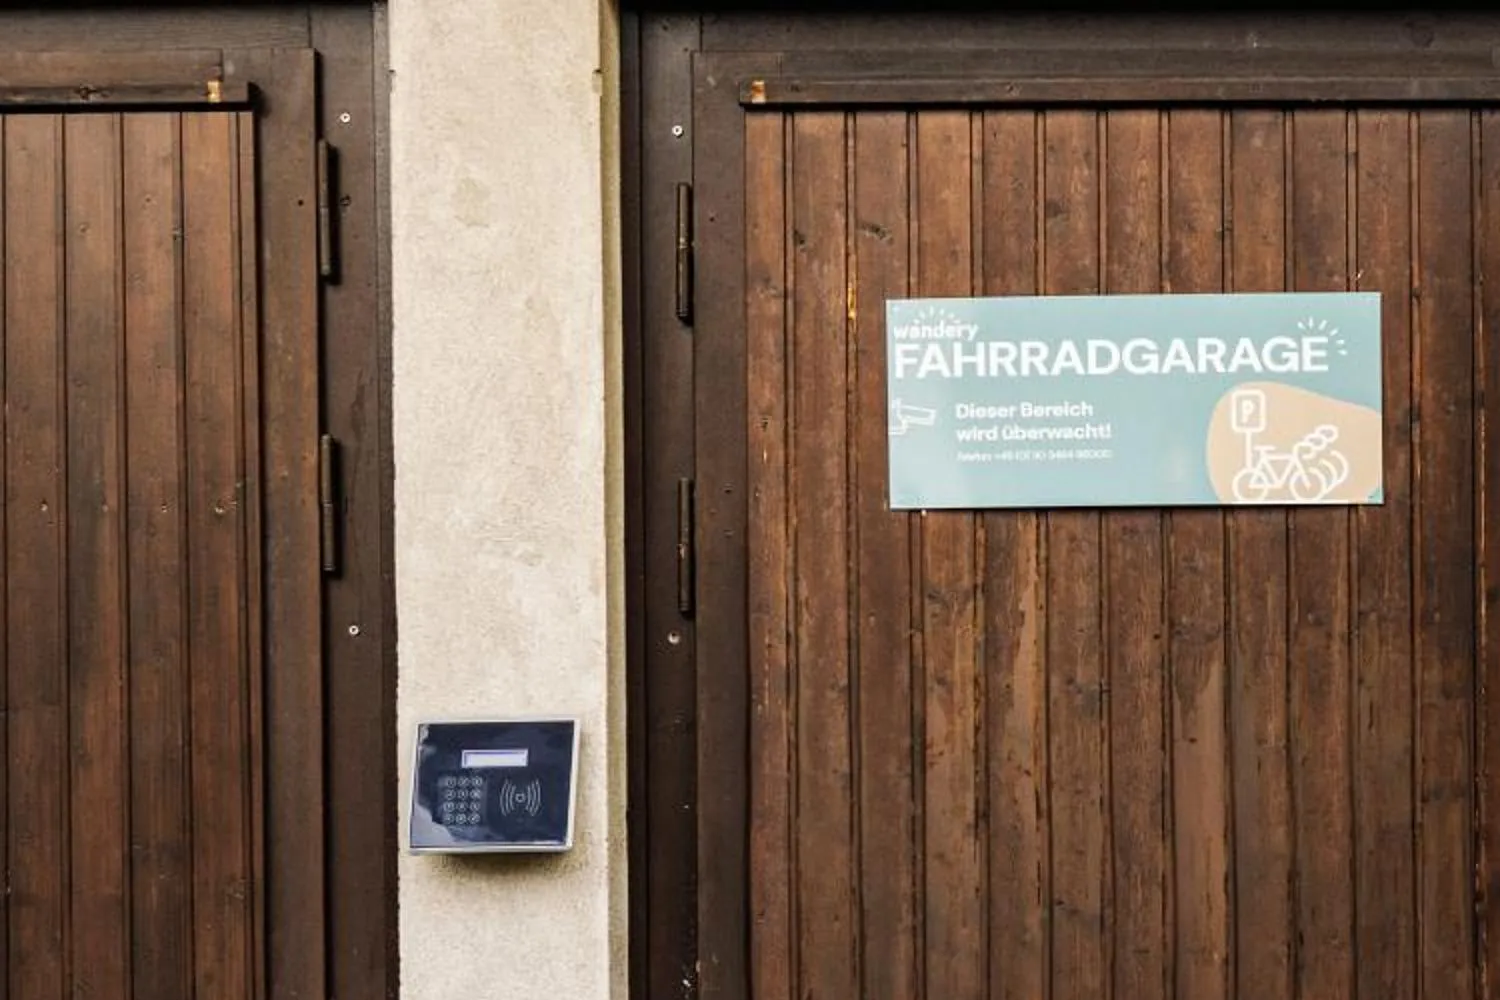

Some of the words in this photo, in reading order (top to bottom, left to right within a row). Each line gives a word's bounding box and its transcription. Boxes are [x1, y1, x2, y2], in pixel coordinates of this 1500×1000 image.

[893, 319, 979, 341] wandery
[894, 336, 1329, 379] FAHRRADGARAGE
[955, 403, 1016, 419] Dieser
[1021, 400, 1094, 418] Bereich
[956, 425, 999, 442] wird
[1001, 423, 1112, 441] überwacht!
